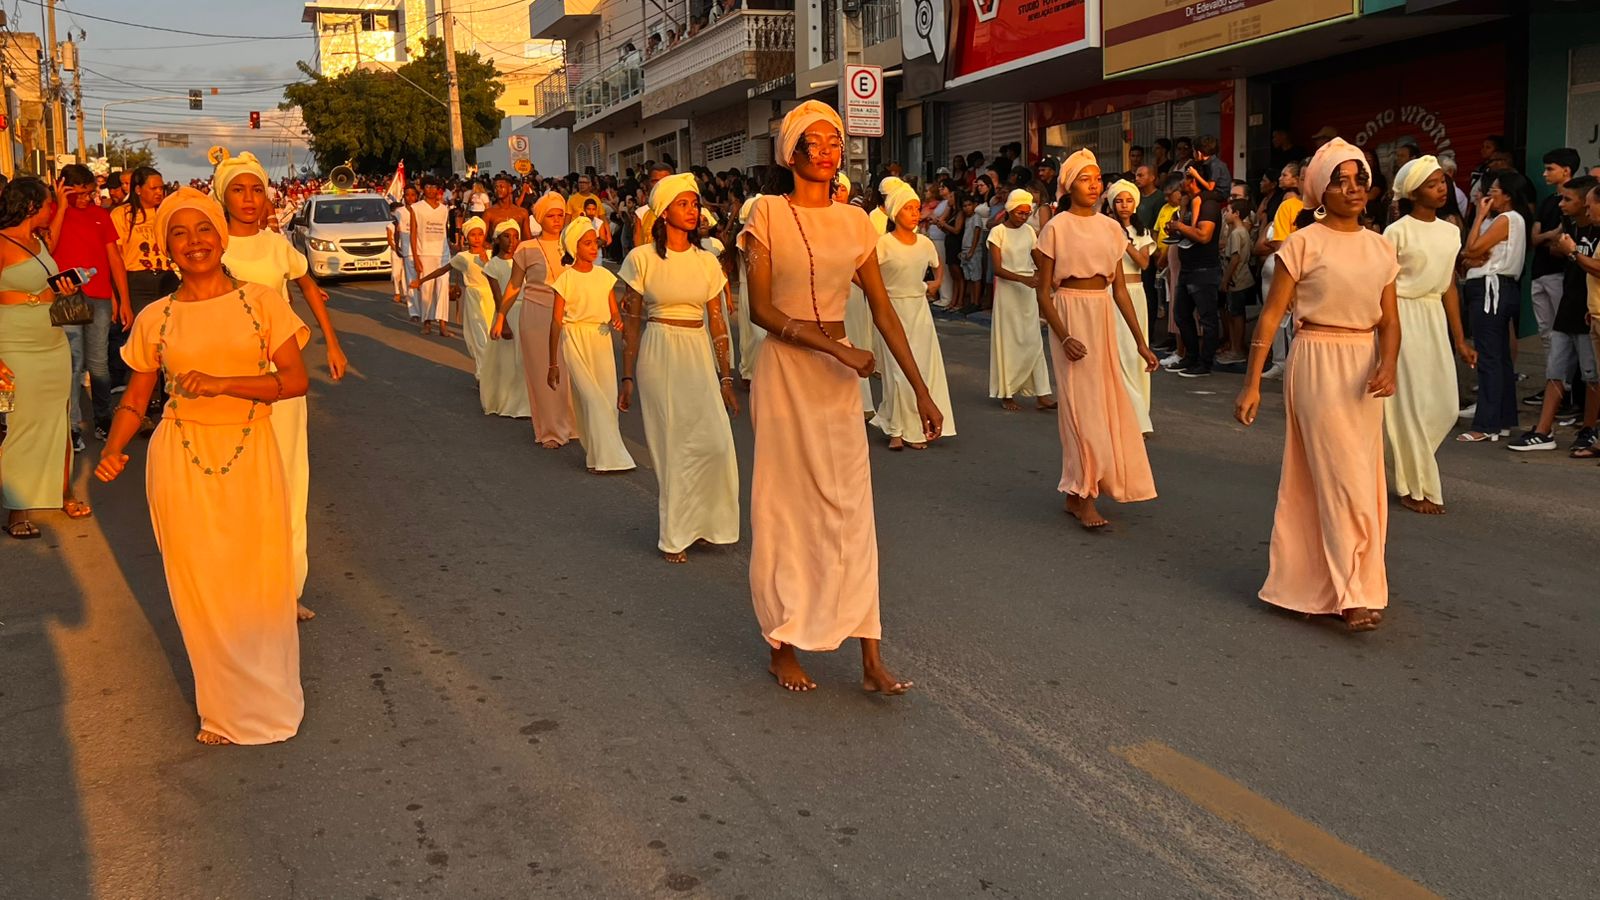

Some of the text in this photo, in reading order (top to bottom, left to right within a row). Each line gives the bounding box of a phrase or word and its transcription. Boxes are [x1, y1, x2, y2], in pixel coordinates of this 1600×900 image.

[1018, 0, 1040, 15] STUDIO
[1185, 6, 1195, 17] Dr.
[860, 76, 868, 92] E
